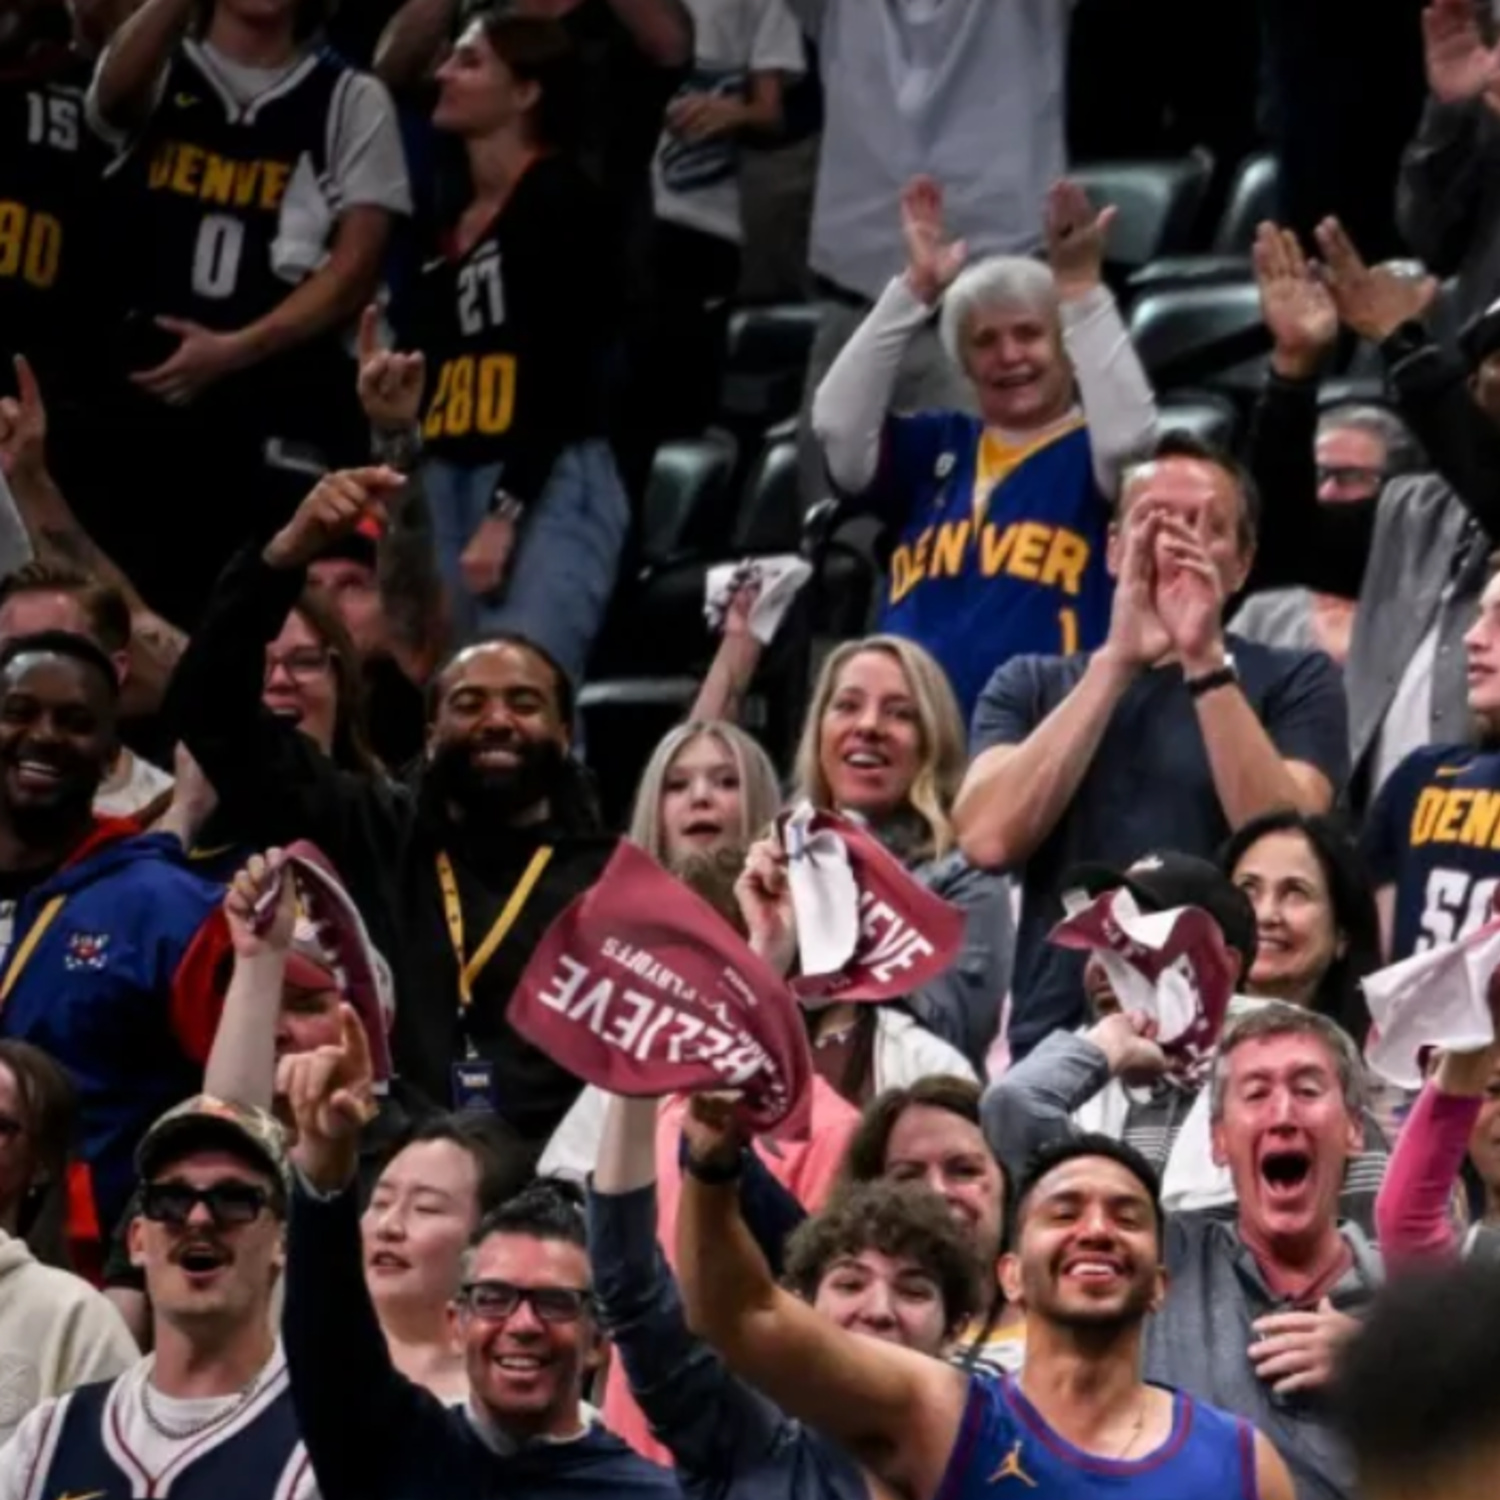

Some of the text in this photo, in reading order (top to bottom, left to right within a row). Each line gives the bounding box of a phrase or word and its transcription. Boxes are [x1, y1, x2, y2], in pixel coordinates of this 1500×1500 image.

[27, 91, 79, 150] 15
[191, 214, 245, 299] 0
[457, 252, 505, 336] 27
[889, 517, 1090, 605] DENVER
[858, 890, 935, 982] EVE
